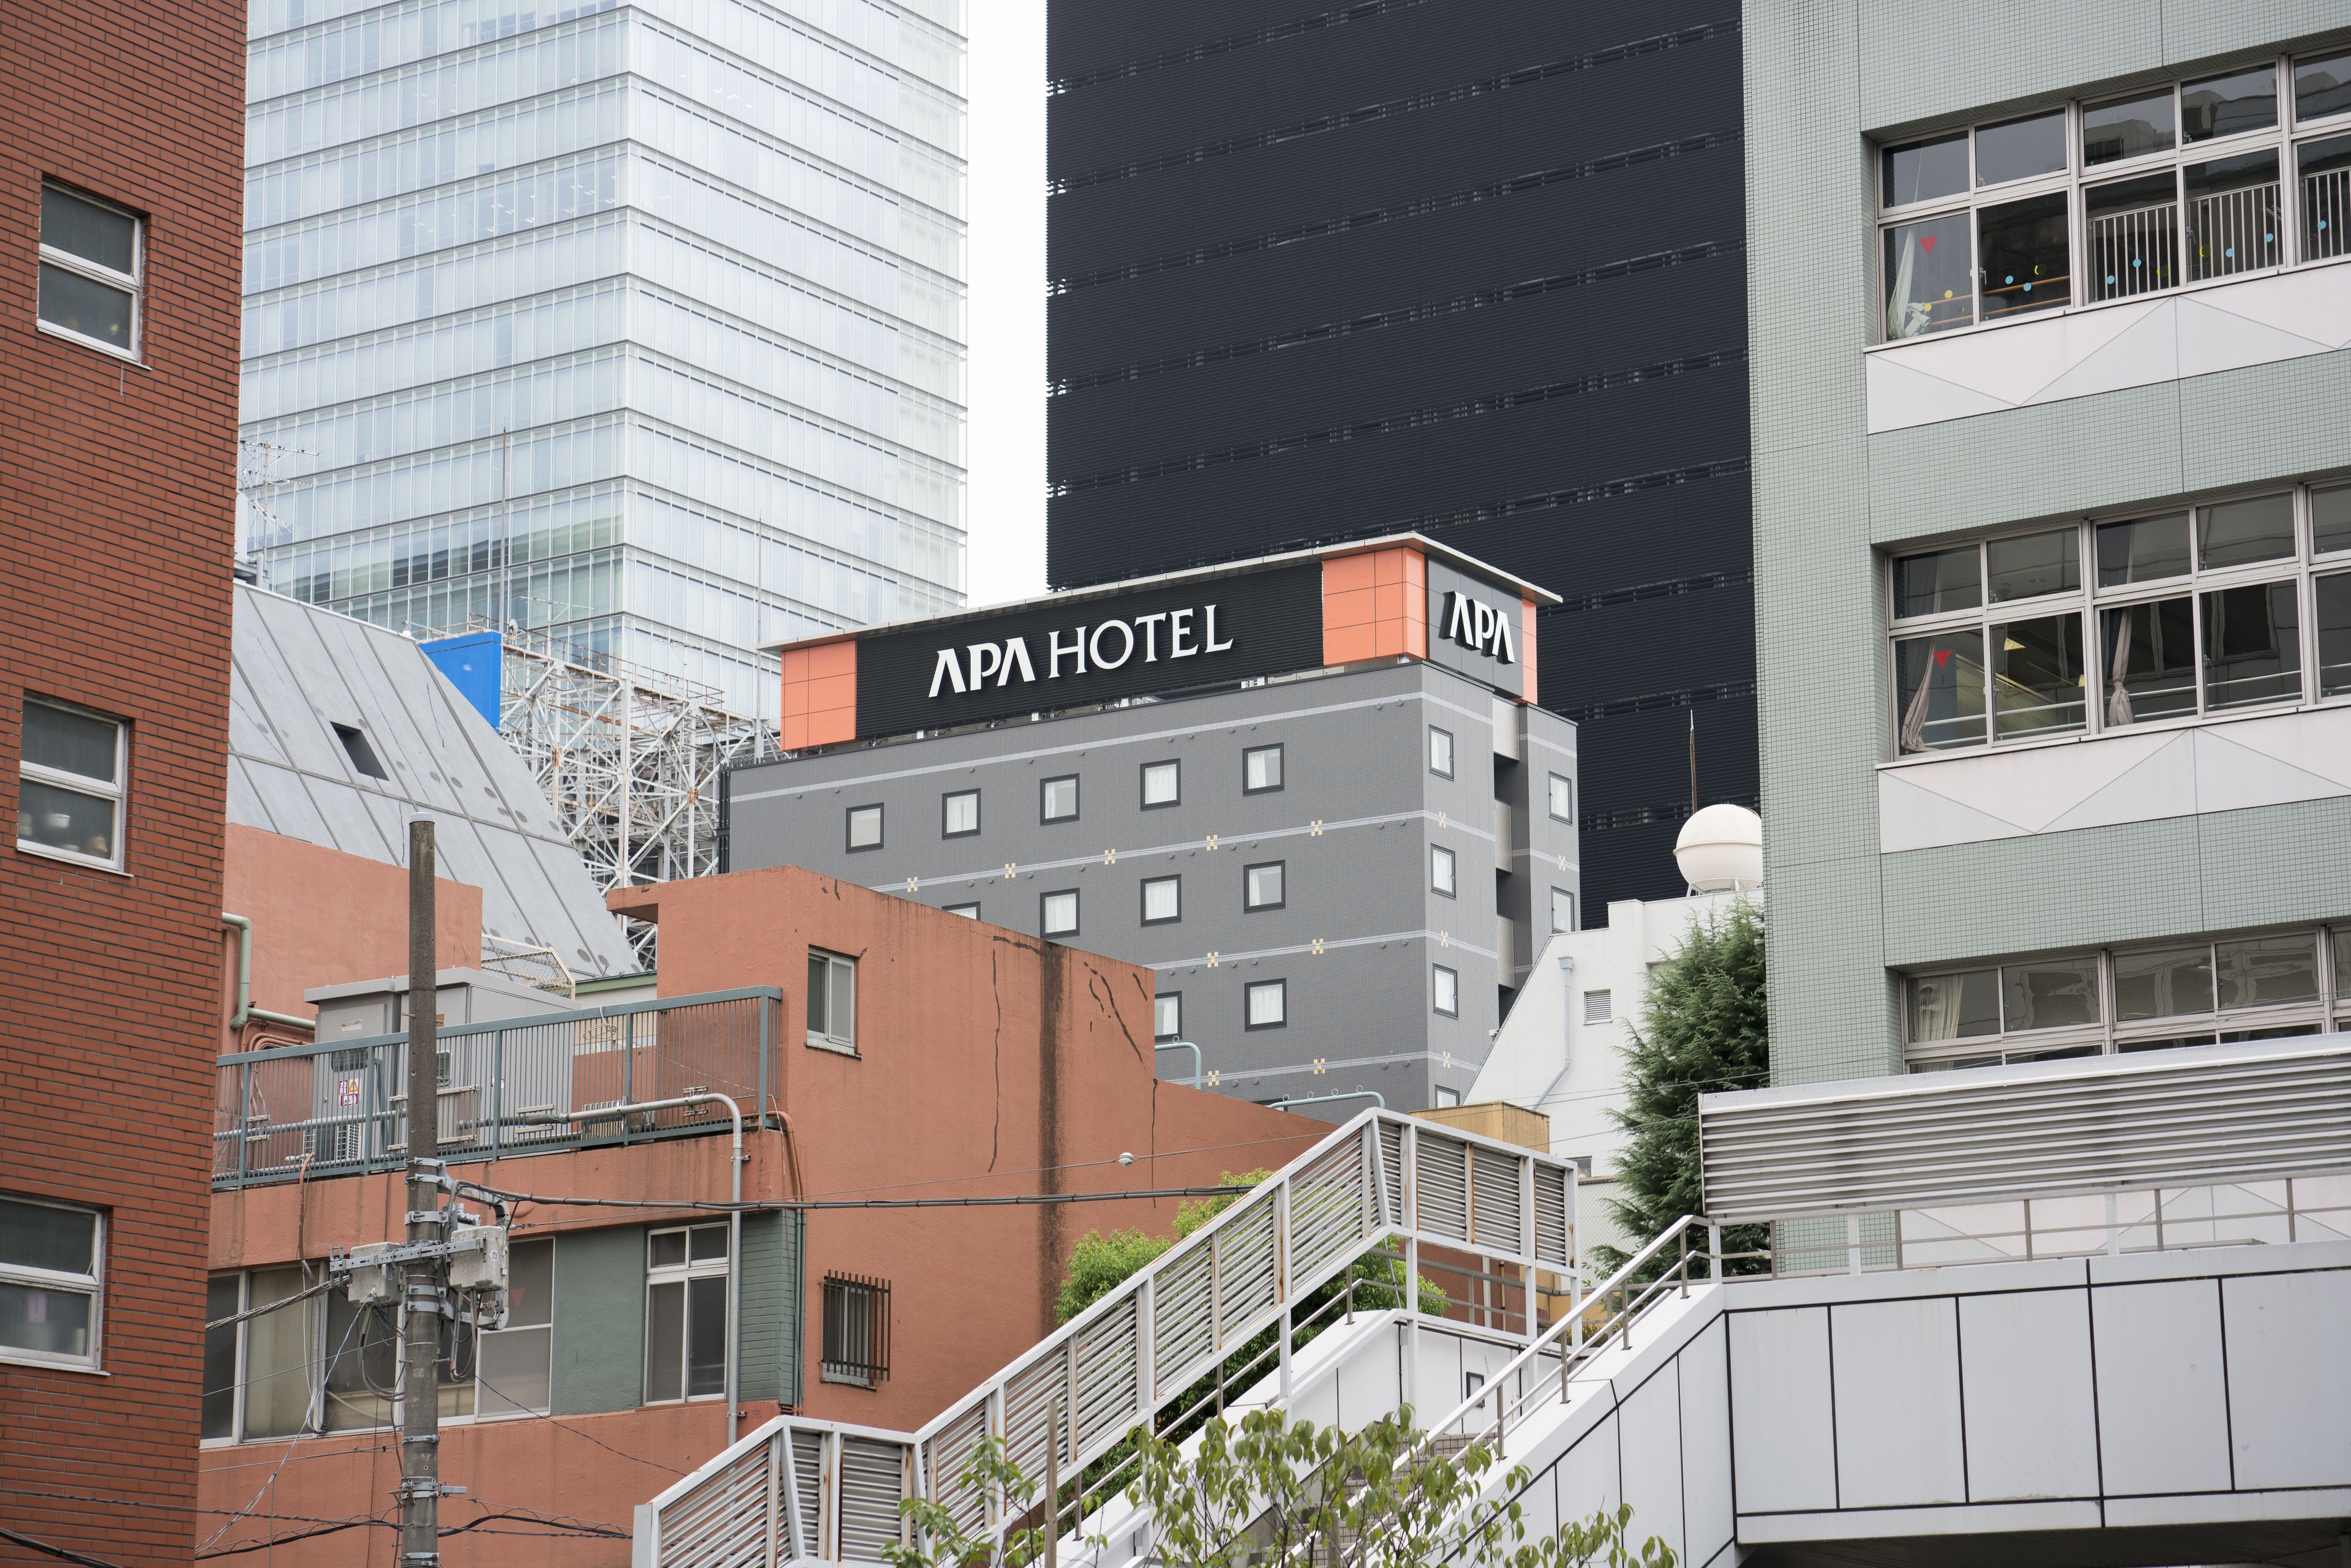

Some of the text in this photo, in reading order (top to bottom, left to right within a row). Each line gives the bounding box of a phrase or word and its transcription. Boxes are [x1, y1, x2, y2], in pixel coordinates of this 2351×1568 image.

[928, 604, 1234, 698] APA HOTEL
[1448, 590, 1515, 664] APA
